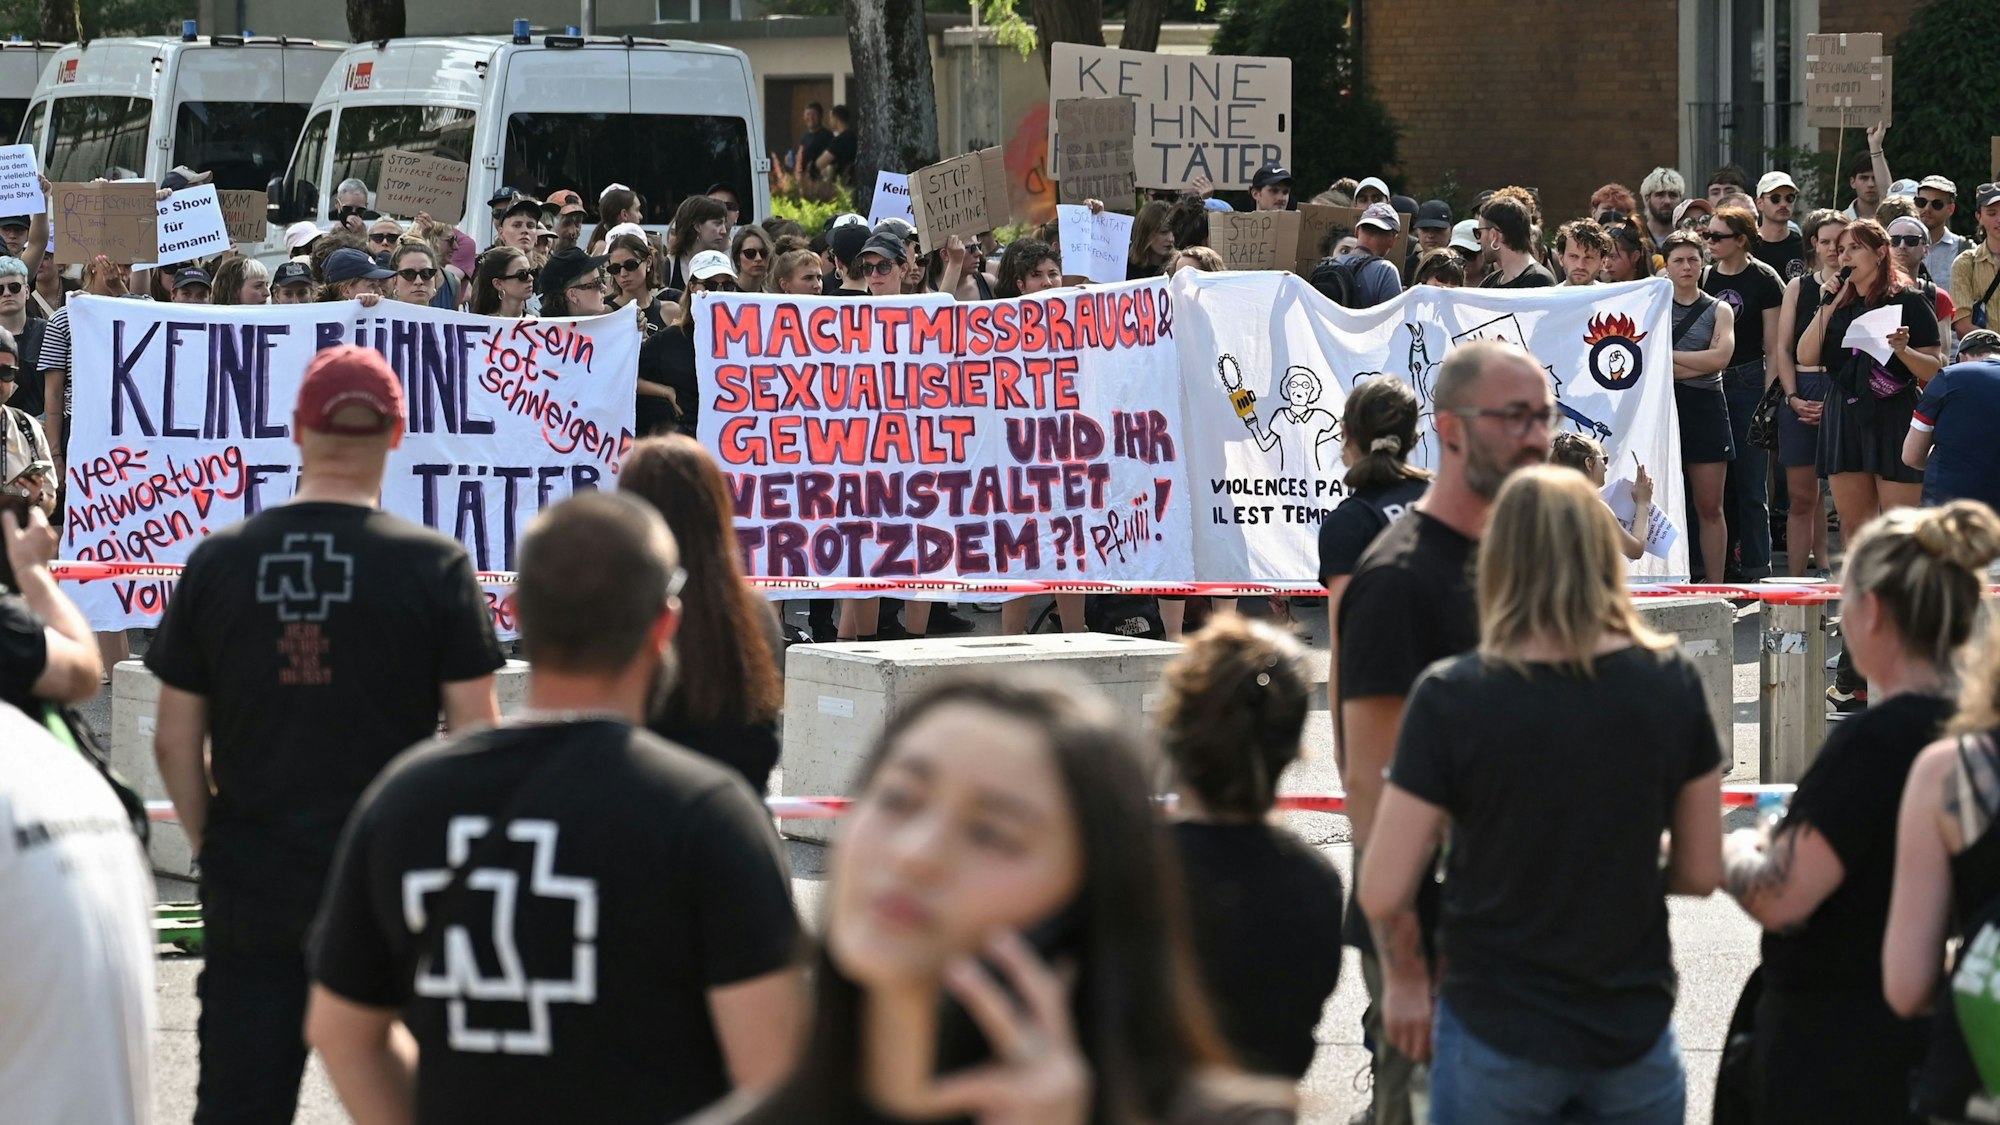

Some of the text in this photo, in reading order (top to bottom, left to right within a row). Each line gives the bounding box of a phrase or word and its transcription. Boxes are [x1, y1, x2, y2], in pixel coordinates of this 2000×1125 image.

[355, 74, 370, 87] POLICE
[1079, 56, 1267, 101] KEINE
[388, 154, 420, 166] STOP
[1066, 140, 1129, 172] RAPE
[4, 171, 36, 180] vielleicht
[384, 178, 411, 191] STOP
[929, 164, 970, 194] STOP
[16, 191, 34, 199] Shyx
[172, 196, 212, 212] Show
[220, 193, 251, 209] NSAM
[164, 221, 184, 234] für
[1228, 216, 1272, 241] STOP
[158, 230, 221, 254] demann!
[710, 287, 1157, 359] MACHTMISSBRAUCH
[481, 327, 560, 382] tot-
[511, 319, 595, 374] Kein
[111, 319, 291, 440] KEINE
[713, 356, 1081, 413] SEXUALISIERTE
[718, 409, 1178, 467] GEWALT UND IHR
[722, 462, 1111, 520] VERANSTALTET
[1210, 477, 1308, 498] VIOLENCES
[1212, 504, 1330, 525] IL EST TEMP
[730, 516, 1041, 577] TROTZDEM
